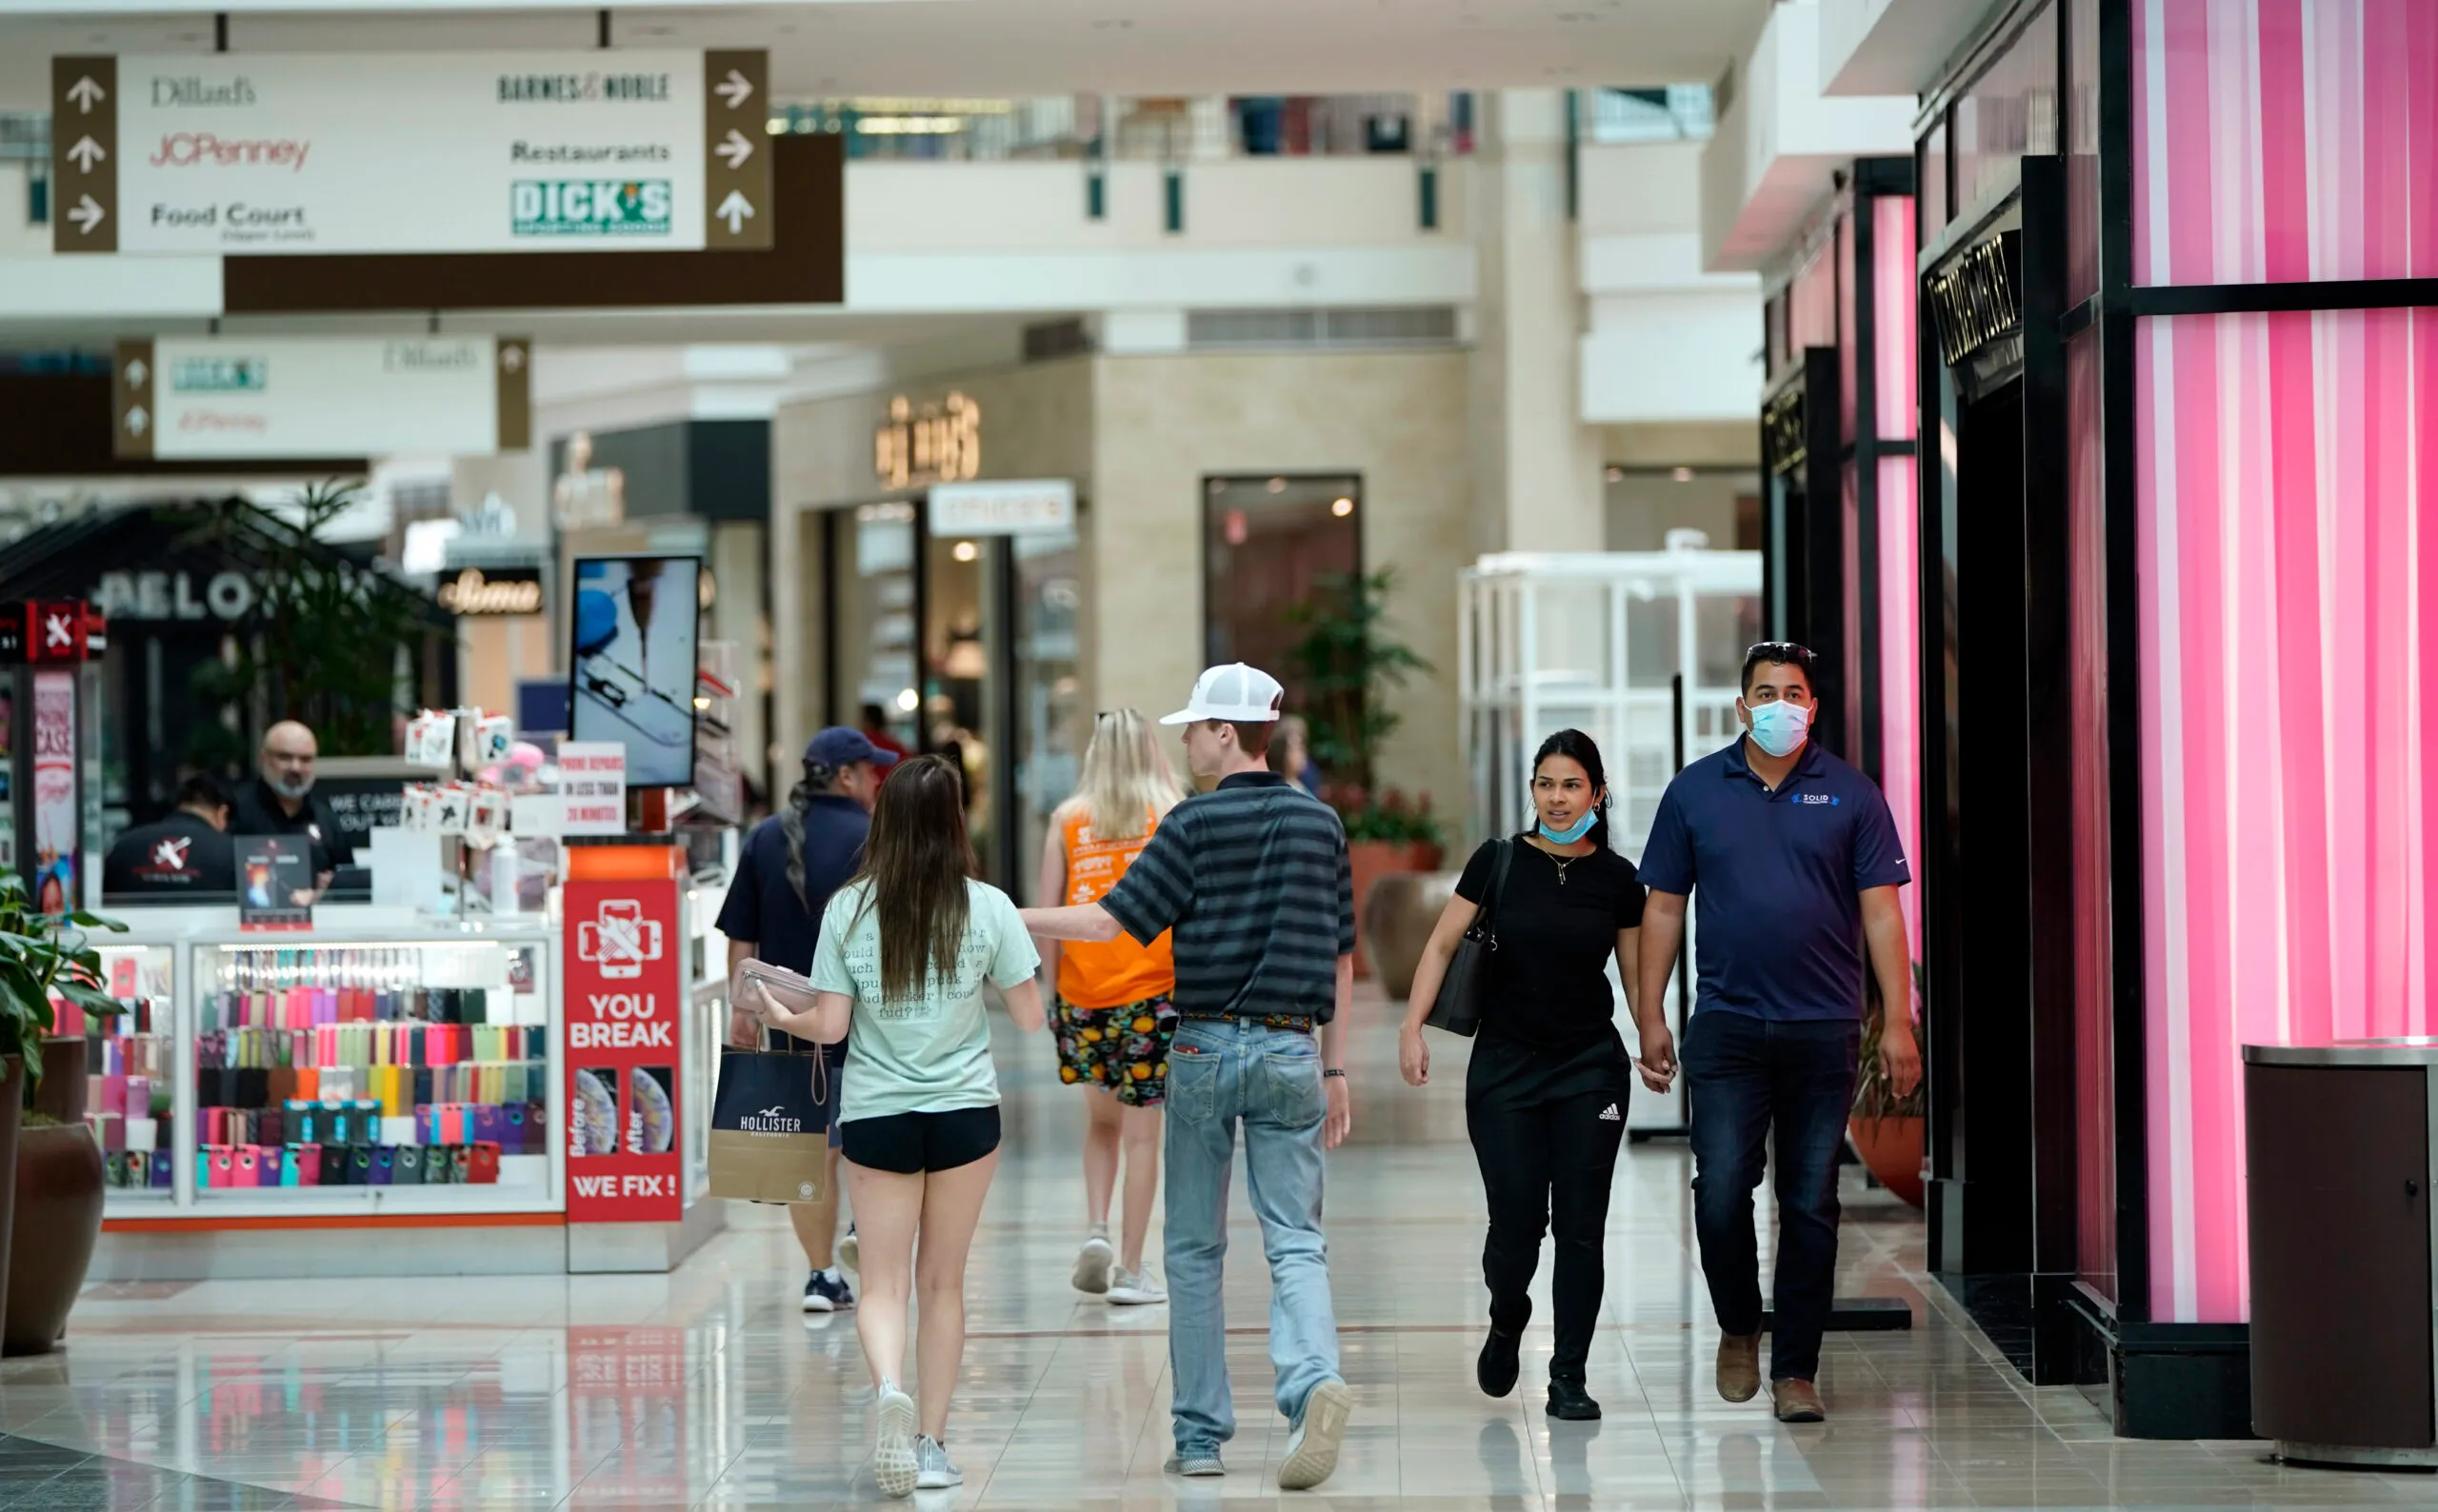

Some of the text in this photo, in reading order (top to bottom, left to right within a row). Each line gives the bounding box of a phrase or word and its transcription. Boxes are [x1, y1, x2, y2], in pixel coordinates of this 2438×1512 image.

[603, 72, 670, 102] NOBLE
[149, 131, 311, 173] JCPenney
[510, 141, 670, 163] Restaurants
[150, 201, 306, 228] Food Court
[513, 181, 669, 223] DICK'S
[844, 947, 873, 959] ould
[848, 963, 873, 974] uch
[588, 993, 655, 1019] YOU
[570, 1022, 672, 1047] BREAK
[569, 1098, 587, 1158] Before
[626, 1109, 644, 1155] After
[740, 1116, 801, 1132] HOLLISTER
[573, 1176, 618, 1197] WE
[622, 1175, 663, 1197] FIX
